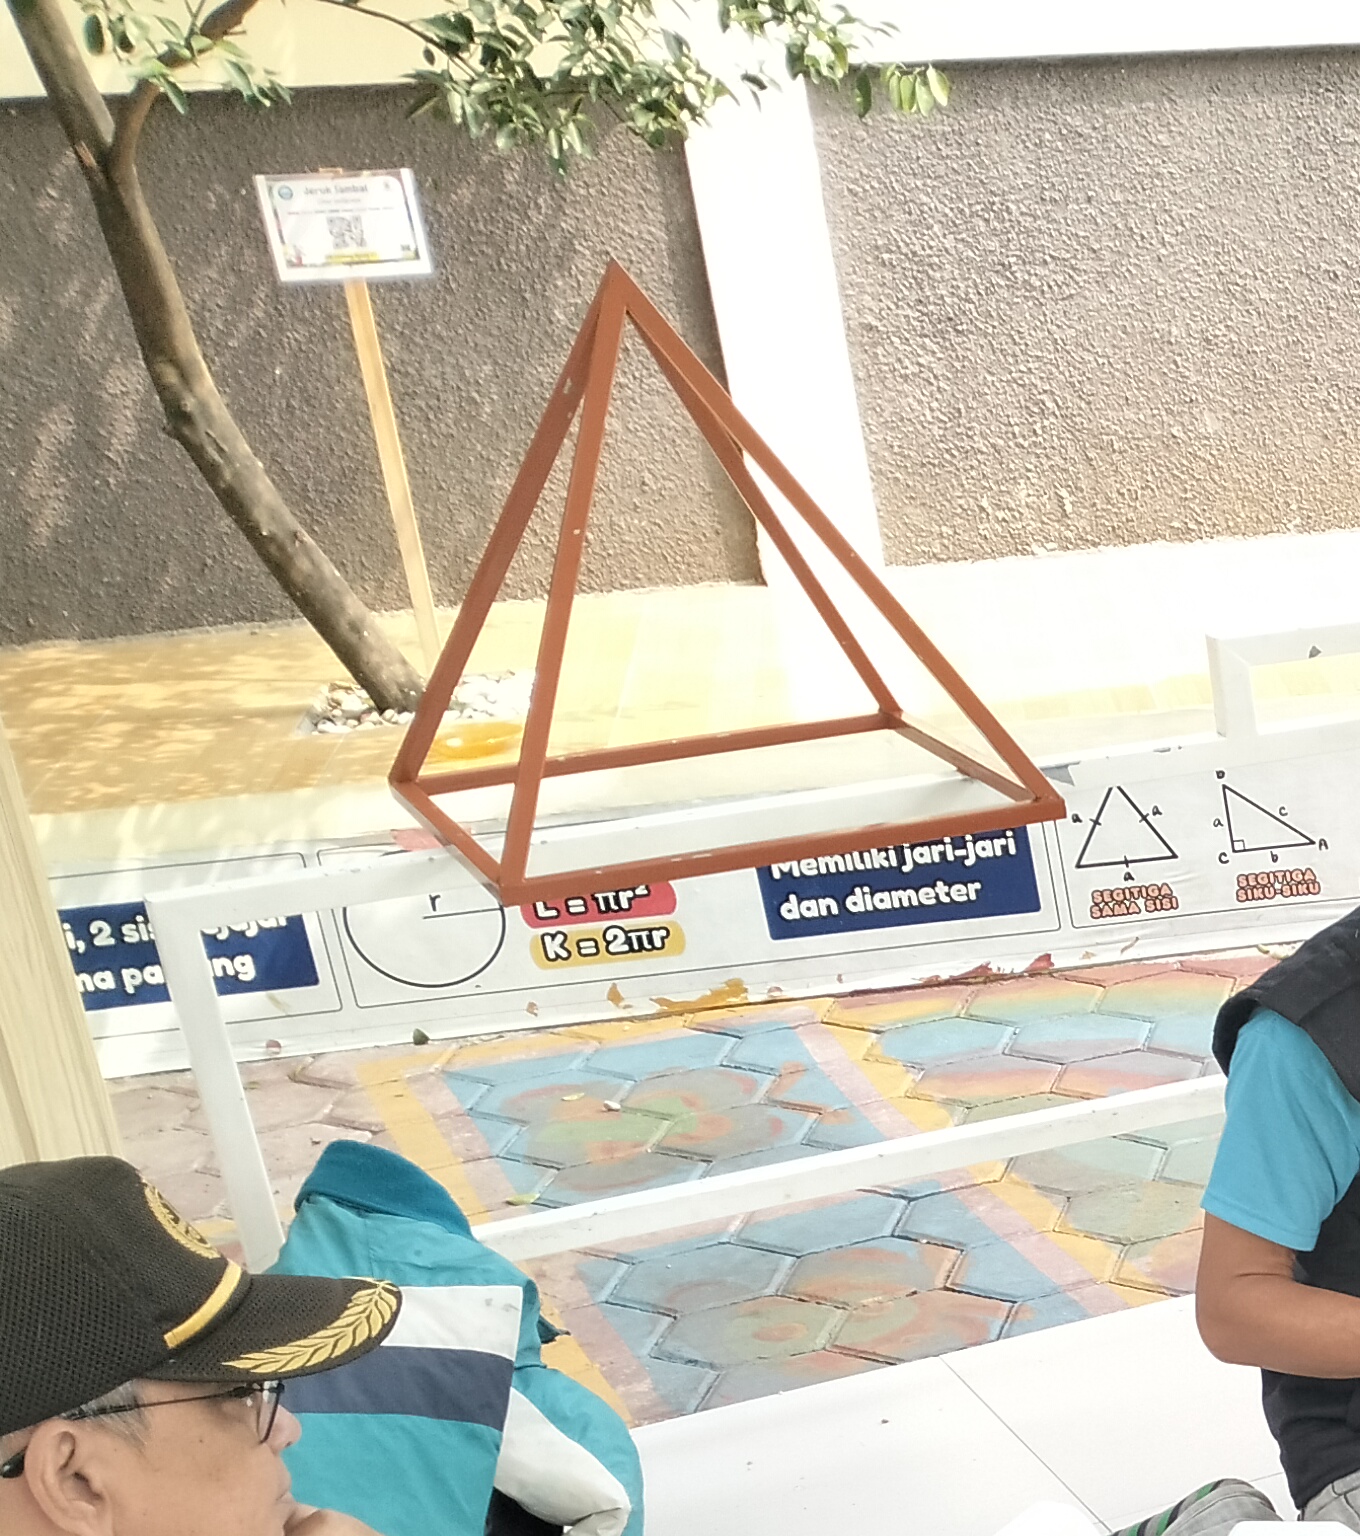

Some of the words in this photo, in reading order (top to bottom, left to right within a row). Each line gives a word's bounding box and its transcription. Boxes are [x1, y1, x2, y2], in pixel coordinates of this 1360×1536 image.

[901, 831, 1016, 873] jari-jari
[1237, 868, 1317, 888] SEGITIGA
[780, 894, 839, 921] dan
[845, 880, 982, 914] diameter
[1091, 882, 1173, 904] SEGITIGA
[1236, 881, 1321, 902] SIKU-SIKU
[1090, 901, 1141, 919] SAMA
[1144, 896, 1179, 912] SISI
[541, 931, 572, 961] K
